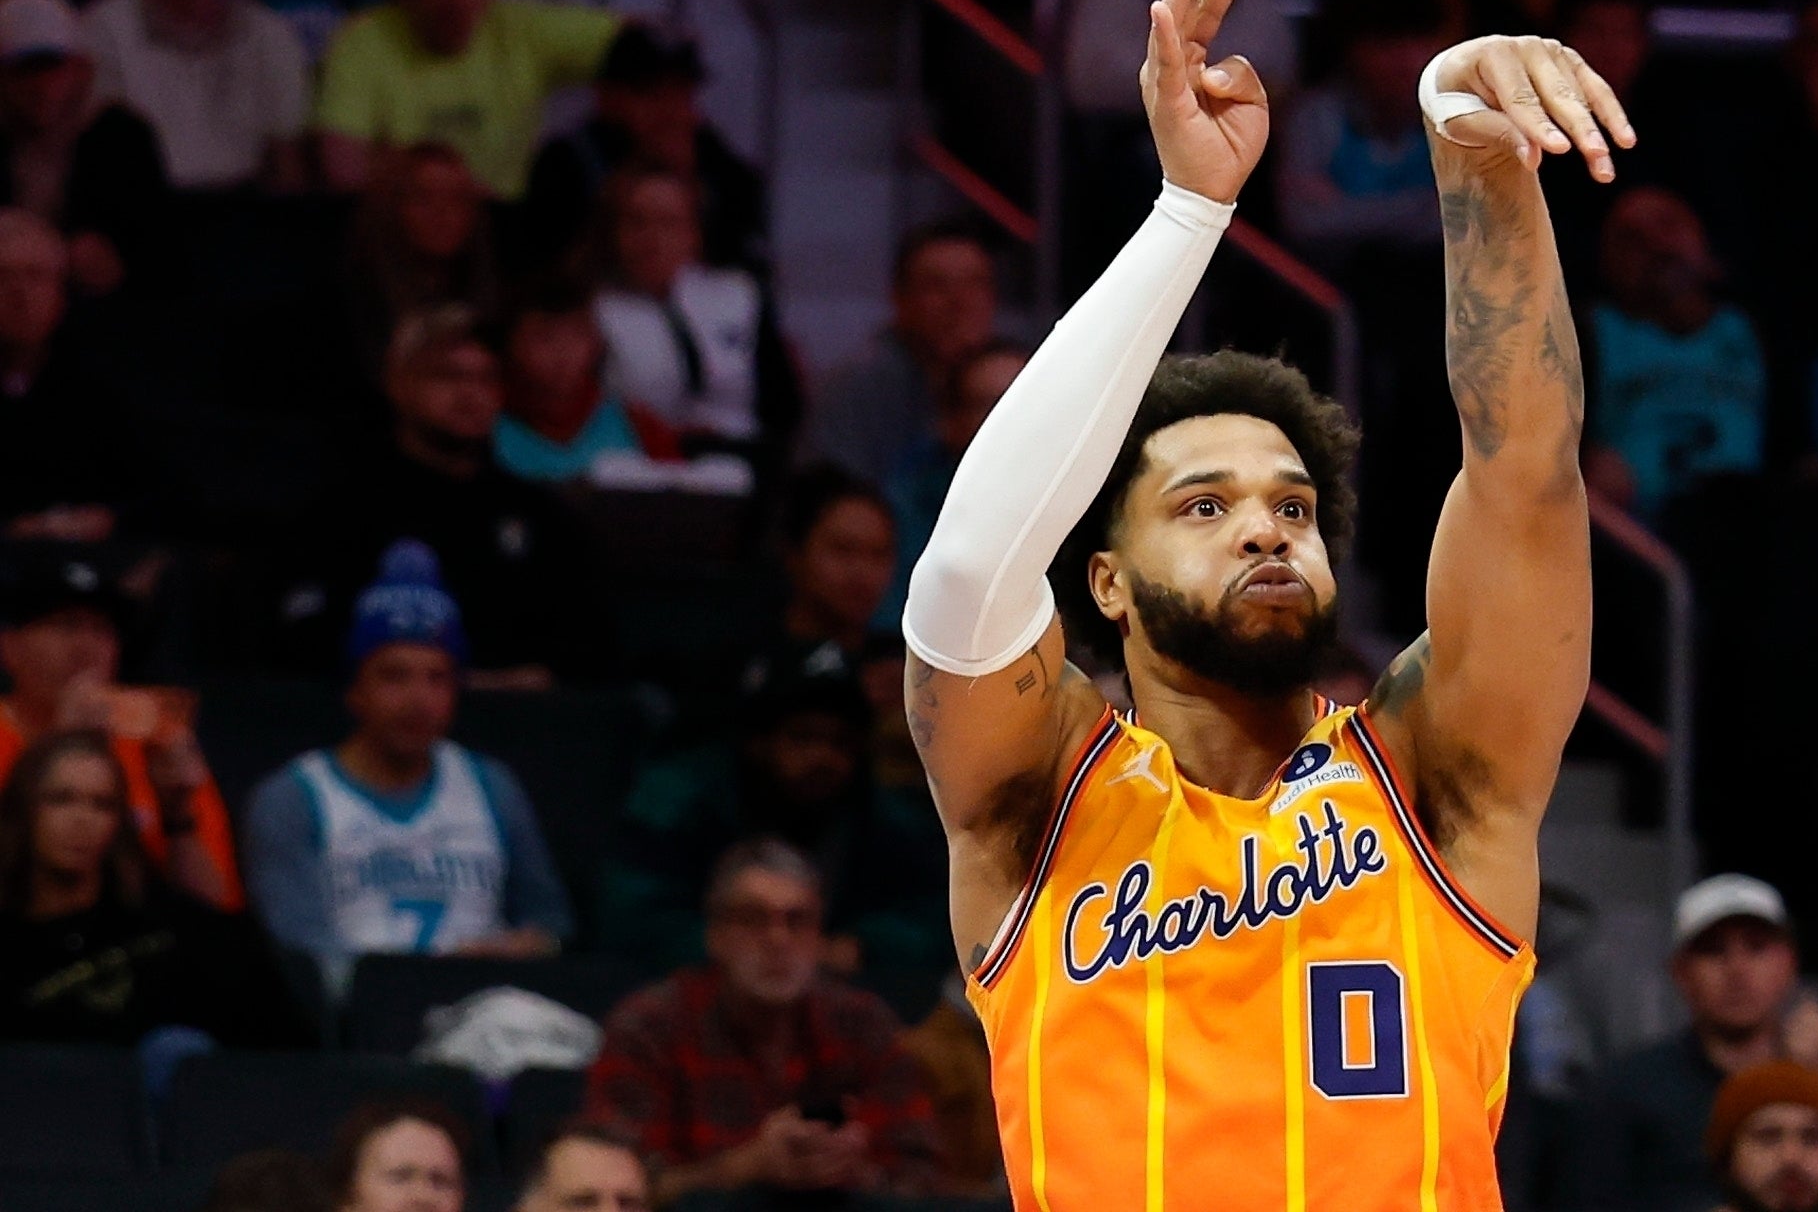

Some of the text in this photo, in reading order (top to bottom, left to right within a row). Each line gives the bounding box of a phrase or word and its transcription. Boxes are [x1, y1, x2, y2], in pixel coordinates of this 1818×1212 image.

[1308, 764, 1362, 786] Health
[1063, 801, 1385, 984] Charlotte
[1307, 960, 1409, 1100] 0
